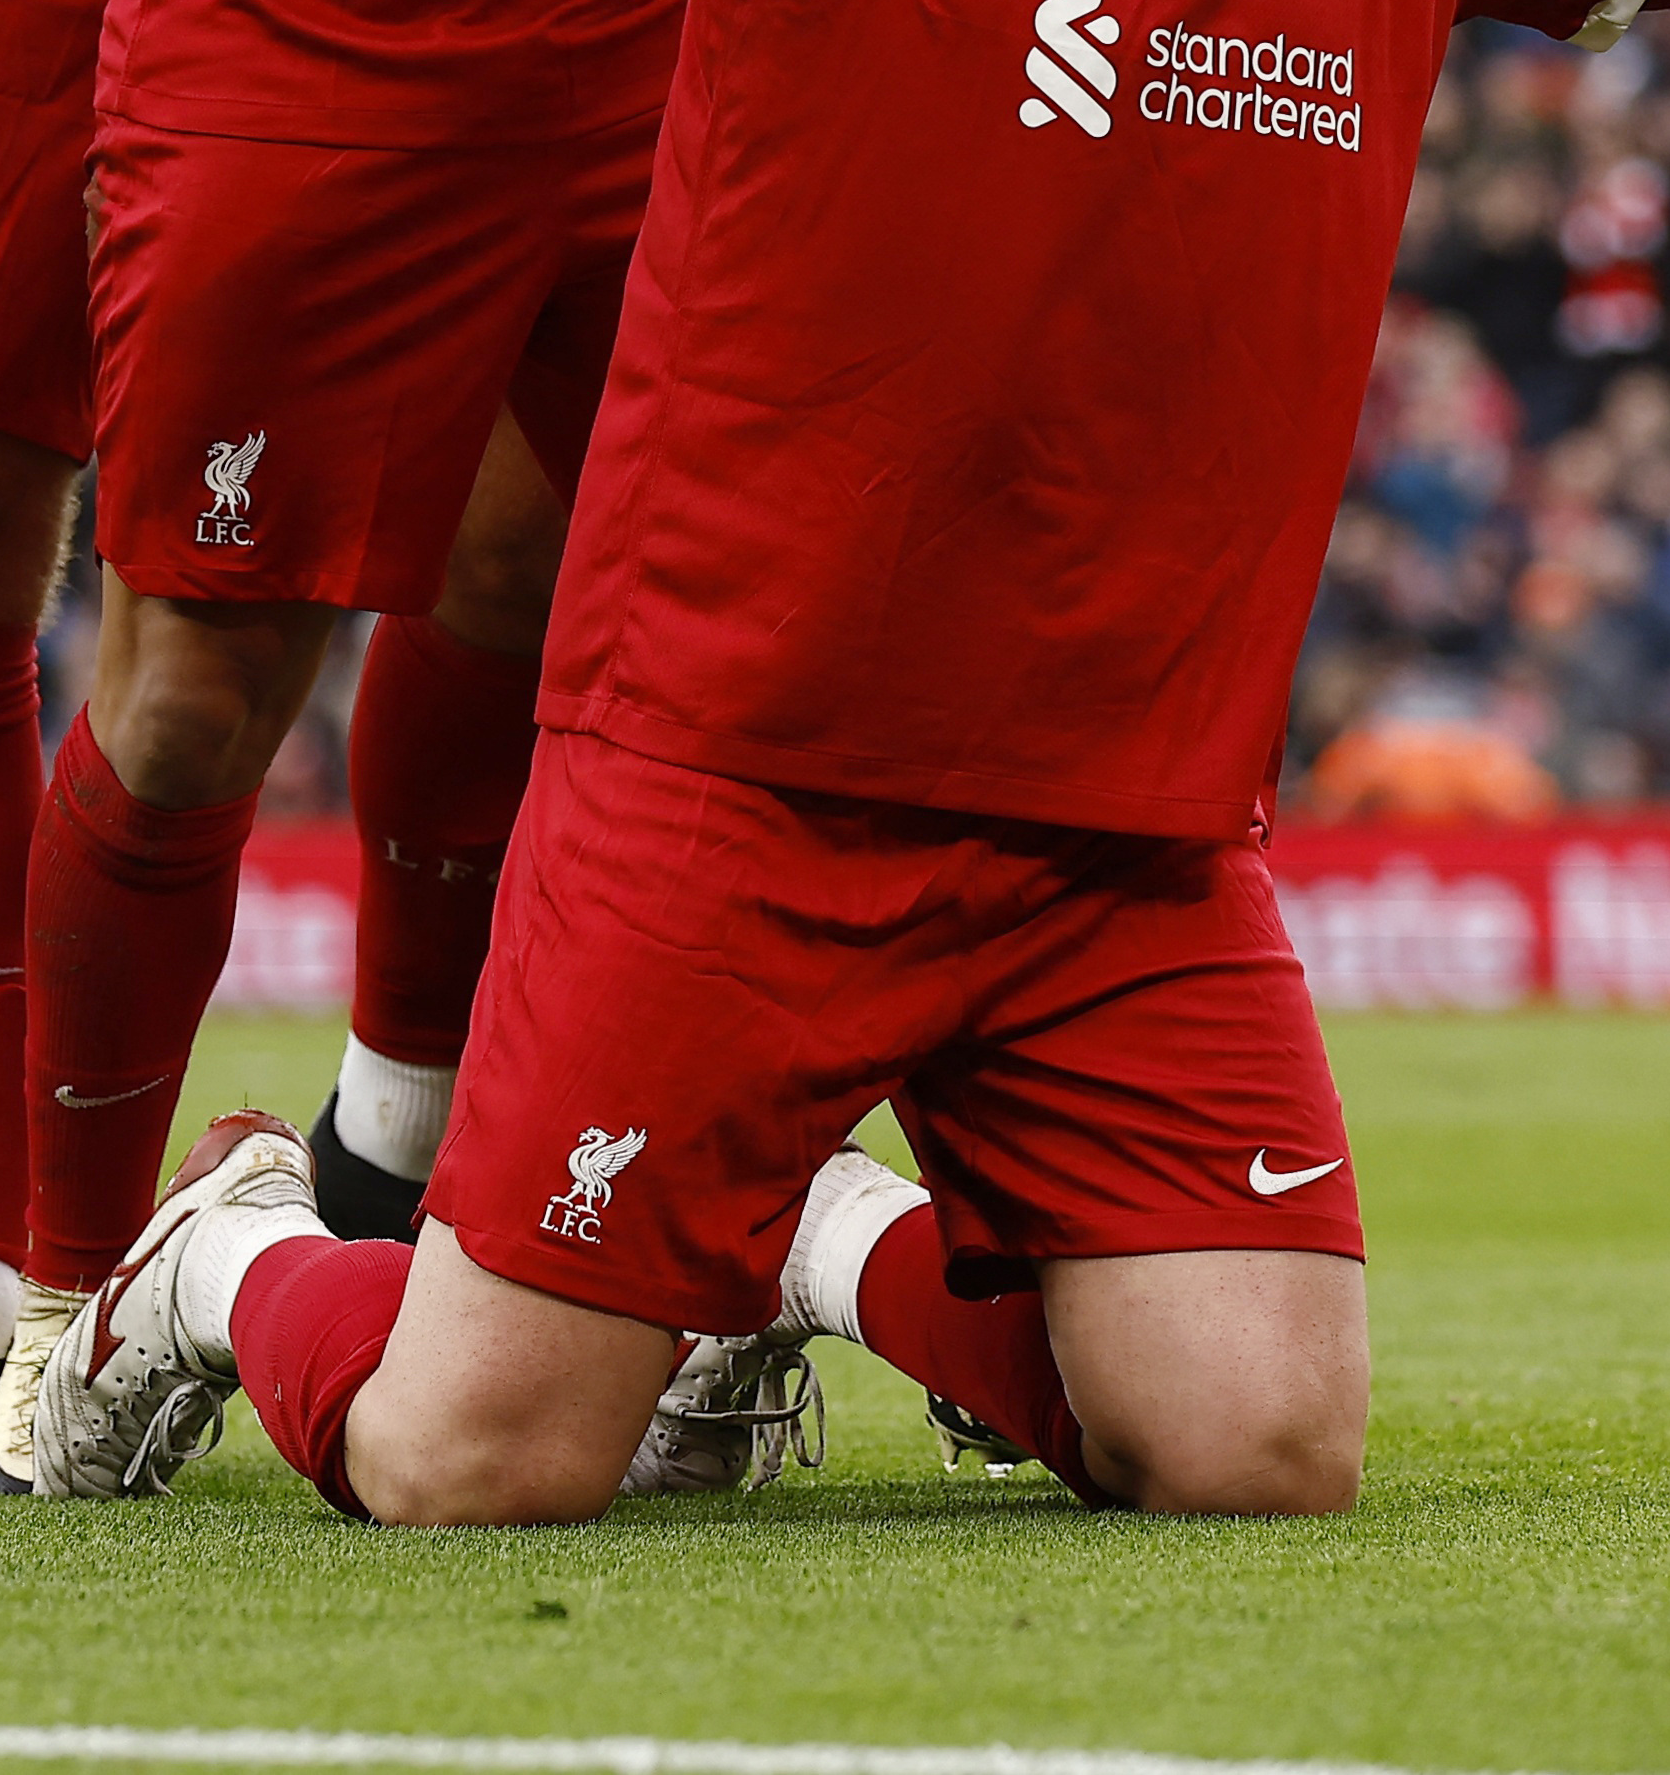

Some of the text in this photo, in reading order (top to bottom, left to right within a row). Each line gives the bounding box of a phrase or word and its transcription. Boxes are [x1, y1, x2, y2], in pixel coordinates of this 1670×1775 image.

[1146, 21, 1353, 98] standard
[1139, 73, 1361, 153] chartered
[195, 519, 255, 546] L.F.C.
[539, 1204, 601, 1244] L.F.C.
